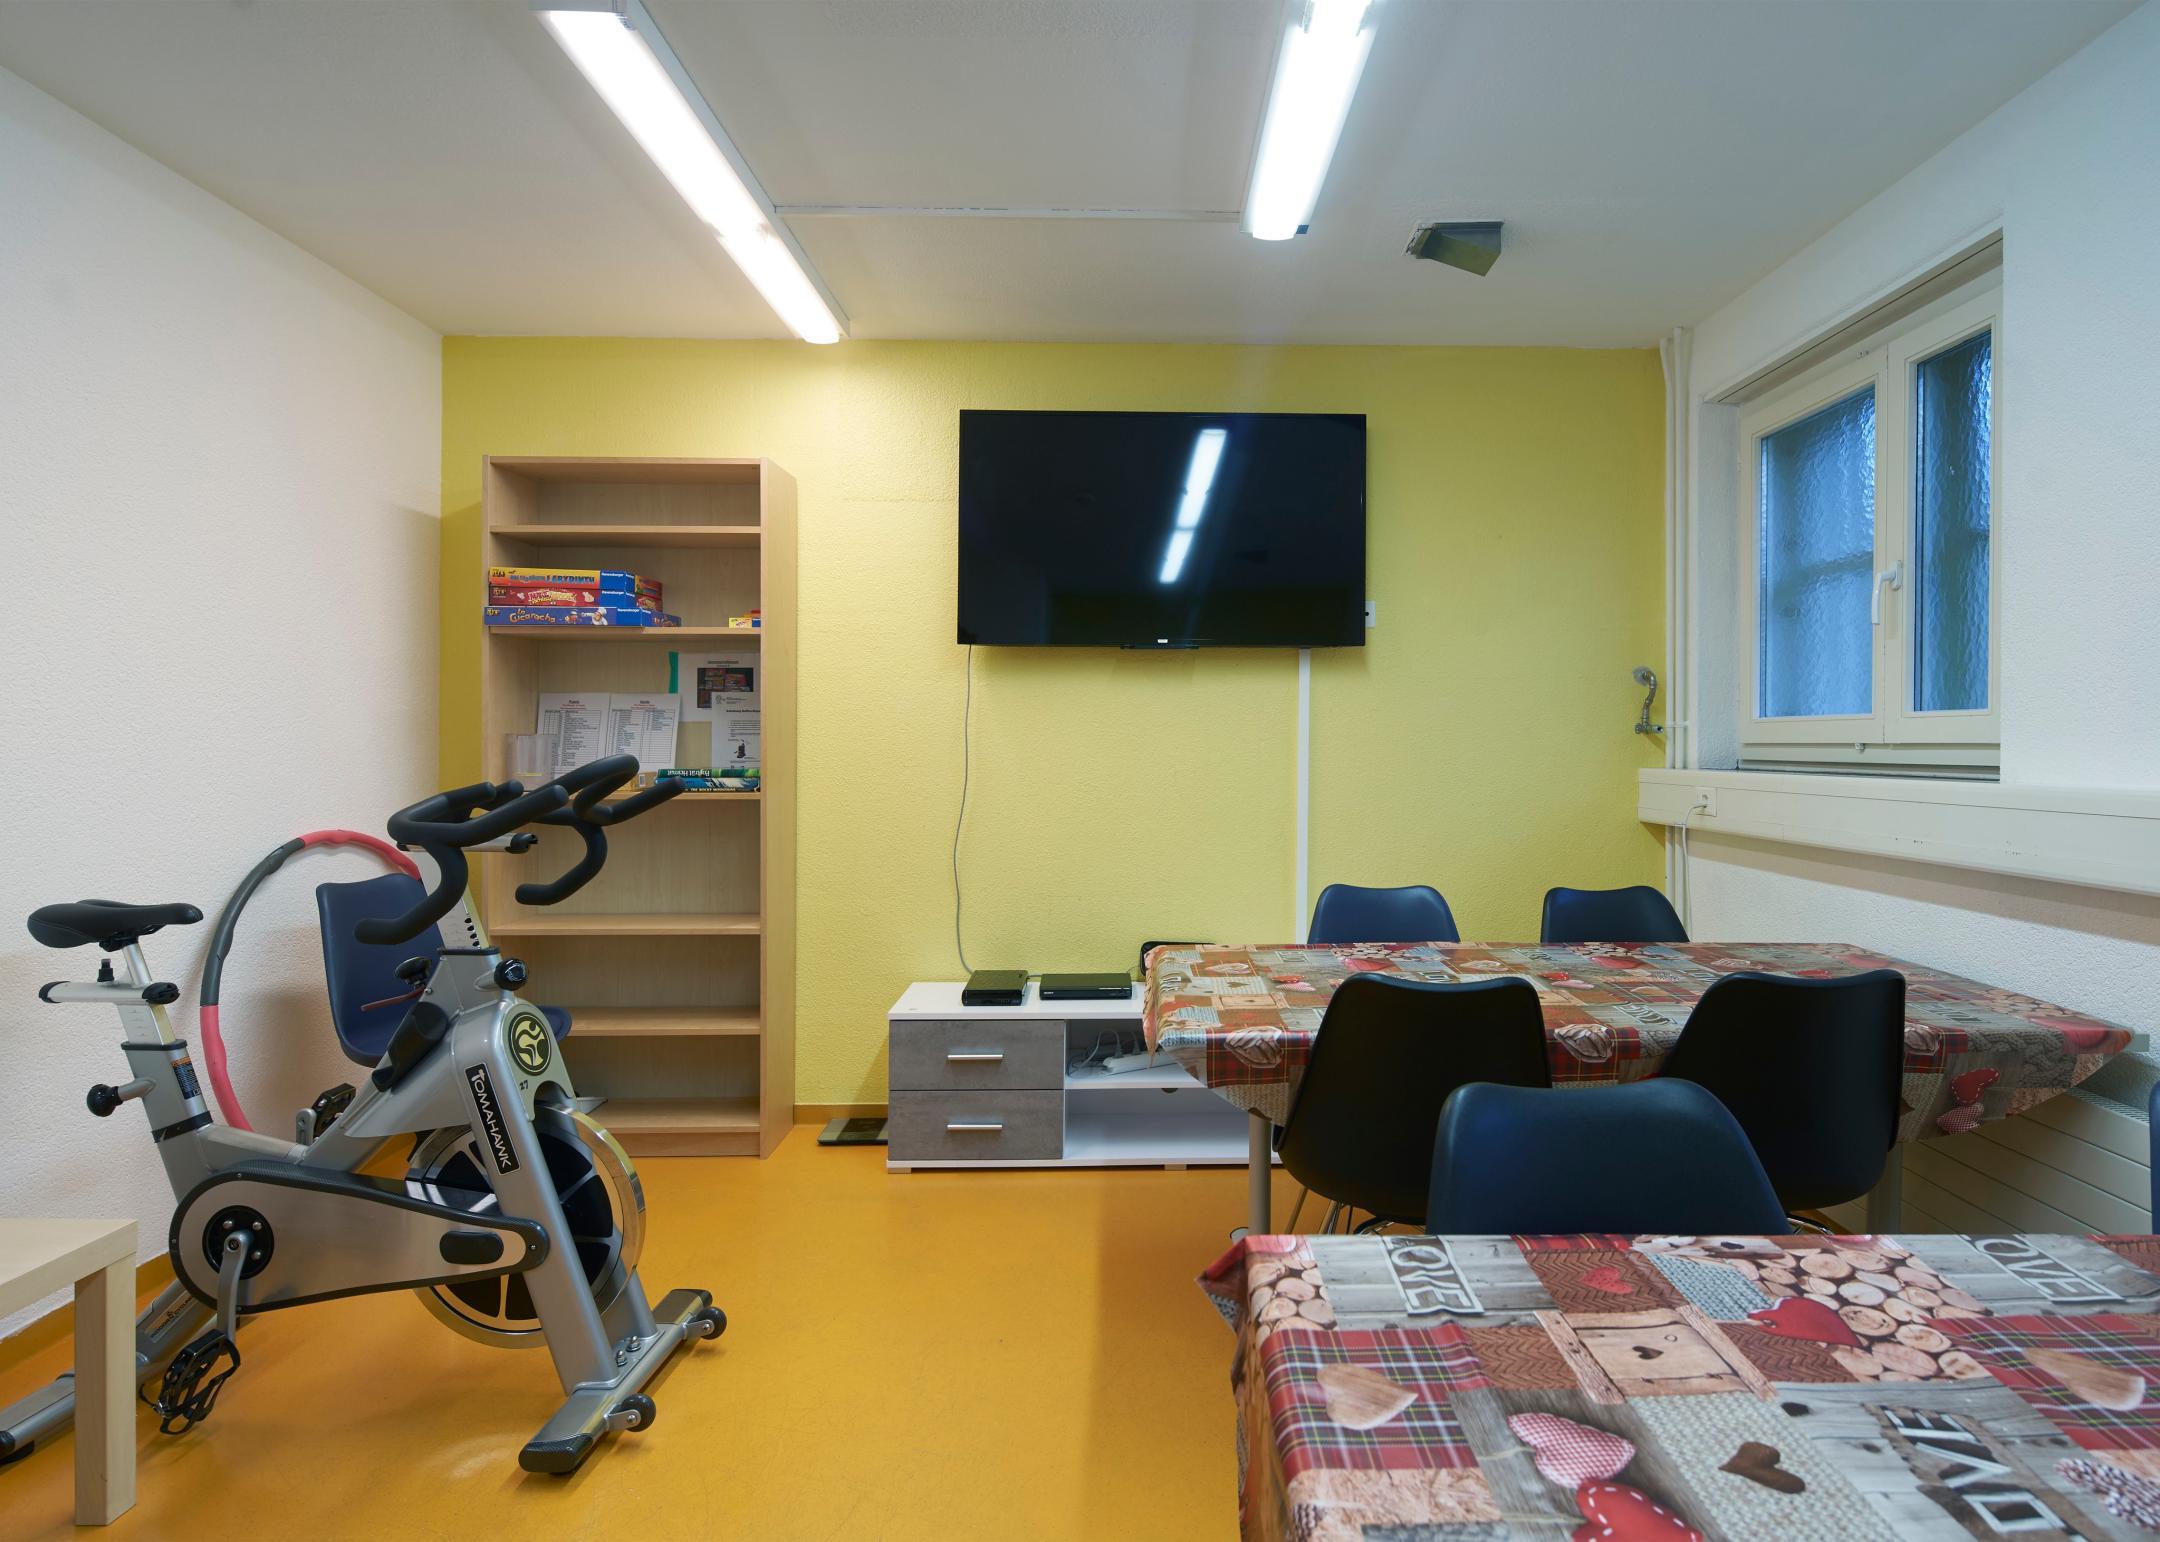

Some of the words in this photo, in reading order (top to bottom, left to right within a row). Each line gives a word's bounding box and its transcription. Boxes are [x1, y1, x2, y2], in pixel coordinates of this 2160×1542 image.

[471, 1068, 512, 1168] TOMAHAWK
[1964, 1235, 2107, 1296] OVE
[1884, 1409, 2088, 1542] OVE
